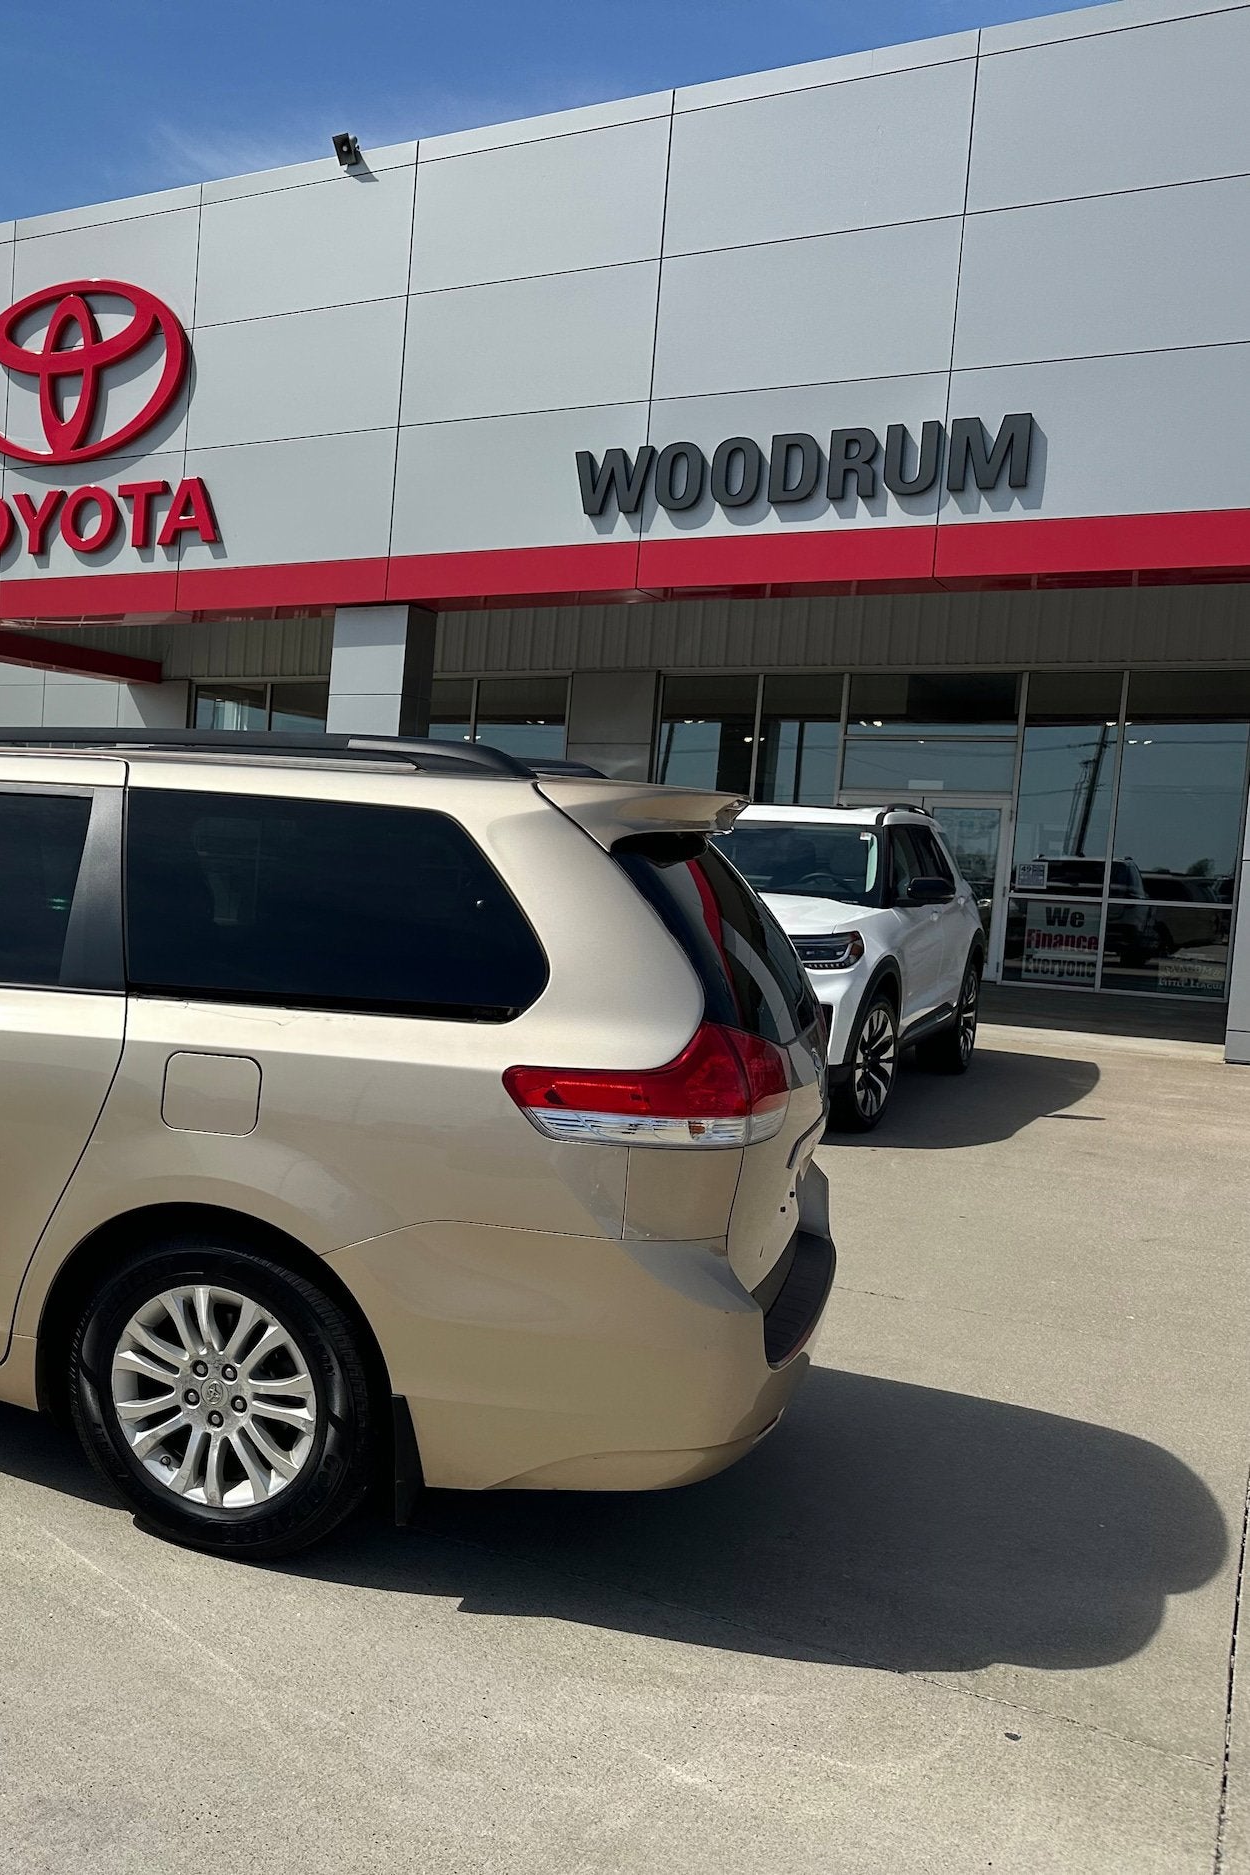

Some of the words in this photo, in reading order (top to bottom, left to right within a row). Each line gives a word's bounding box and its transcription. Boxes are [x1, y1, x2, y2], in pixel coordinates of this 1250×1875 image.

[575, 413, 1033, 515] WOODRUM
[1045, 907, 1085, 928] We
[1026, 928, 1099, 951] Finance
[1024, 954, 1097, 978] Everyone
